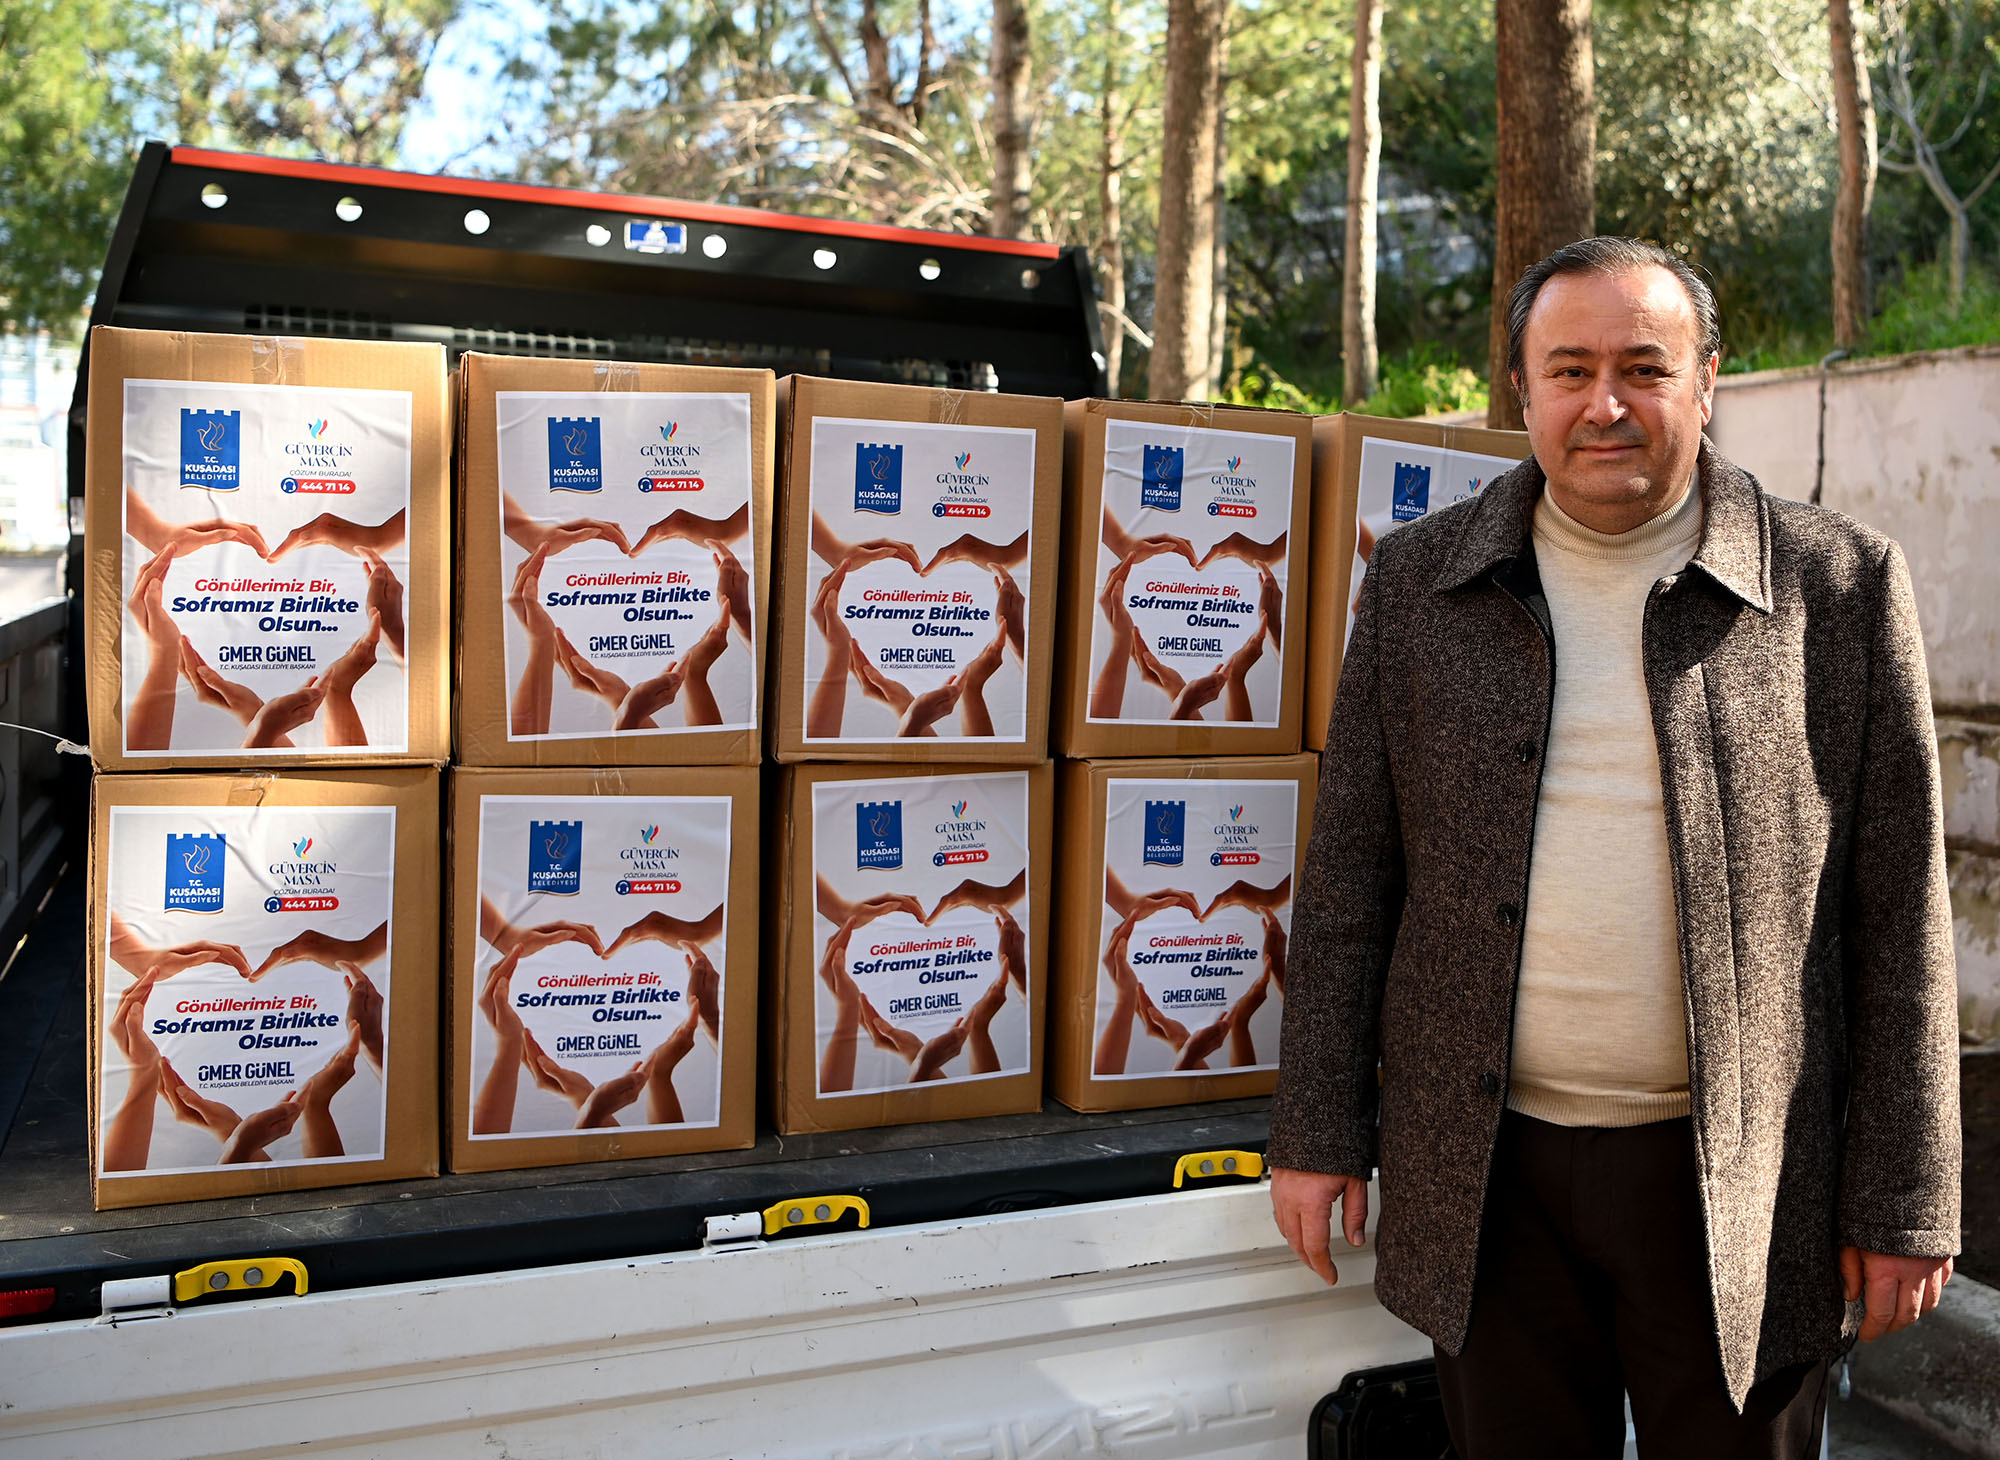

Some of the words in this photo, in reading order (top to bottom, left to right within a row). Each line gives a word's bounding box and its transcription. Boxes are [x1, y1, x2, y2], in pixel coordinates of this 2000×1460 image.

[285, 443, 352, 456] GÜVERCİN
[641, 444, 700, 456] GÜVERCİN
[300, 457, 337, 467] MASA
[654, 457, 687, 466] MASA
[185, 464, 236, 473] KUŞADASI
[553, 468, 598, 476] KUŞADASI
[185, 473, 236, 481] BELEDİYESİ
[937, 473, 989, 485] GÜVERCİN
[1212, 475, 1256, 487] GÜVERCİN
[301, 482, 323, 491] 444
[325, 483, 336, 491] 71
[338, 483, 350, 491] 14
[656, 481, 676, 489] 444
[677, 481, 687, 489] 71
[948, 485, 976, 495] MASA
[1221, 486, 1245, 496] MASA
[859, 491, 898, 499] KUŞADASI
[948, 507, 965, 515] 444
[566, 571, 663, 586] Gönüllerimiz
[666, 570, 691, 585] Bir,
[195, 579, 305, 592] Gönüllerimiz
[309, 579, 336, 595] Bir,
[1146, 582, 1220, 595] Gönüllerimiz
[1222, 585, 1240, 599] Bir,
[546, 591, 637, 606] Soframız
[641, 586, 711, 603] Birlikte
[863, 590, 949, 602] Gönüllerimiz
[952, 591, 973, 605] Bir,
[171, 597, 275, 612] Soframız
[280, 596, 359, 613] Birlikte
[1129, 595, 1199, 611] Soframız
[1201, 598, 1254, 613] Birlikte
[623, 607, 694, 622] Olsun...
[845, 605, 925, 619] Soframız
[929, 605, 990, 620] Birlikte
[258, 616, 338, 632] Olsun...
[912, 623, 974, 637] Olsun...
[935, 820, 986, 833] GÜVERCİN
[1214, 824, 1258, 834] GÜVERCİN
[947, 833, 974, 842] MASA
[1224, 835, 1248, 844] MASA
[620, 847, 679, 859] GÜVERCİN
[948, 854, 965, 862] 444
[966, 853, 974, 861] 71
[270, 861, 336, 874] GÜVERCİN
[633, 860, 665, 869] MASA
[284, 875, 320, 885] MASA
[533, 871, 577, 879] KUŞADASI
[189, 879, 203, 887] T.C.
[654, 883, 664, 891] 71
[666, 883, 676, 891] 14
[170, 888, 220, 896] KUŞADASI
[284, 900, 307, 909] 444
[308, 900, 319, 908] 71
[321, 900, 333, 908] 14
[870, 937, 953, 956] Gönüllerimiz
[956, 935, 976, 948] Bir,
[1150, 934, 1223, 947] Gönüllerimiz
[1225, 933, 1244, 946] Bir,
[853, 958, 930, 975] Soframız
[934, 949, 993, 967] Birlikte
[1133, 951, 1202, 965] Soframız
[1205, 947, 1258, 962] Birlikte
[538, 973, 634, 988] Gönüllerimiz
[637, 972, 661, 986] Bir,
[517, 992, 607, 1007] Soframız
[611, 987, 681, 1004] Birlikte
[176, 996, 286, 1013] Gönüllerimiz
[290, 995, 317, 1010] Bir,
[592, 1008, 662, 1022] Olsun...
[152, 1018, 255, 1034] Soframız
[260, 1011, 339, 1030] Birlikte
[239, 1033, 318, 1050] Olsun...
